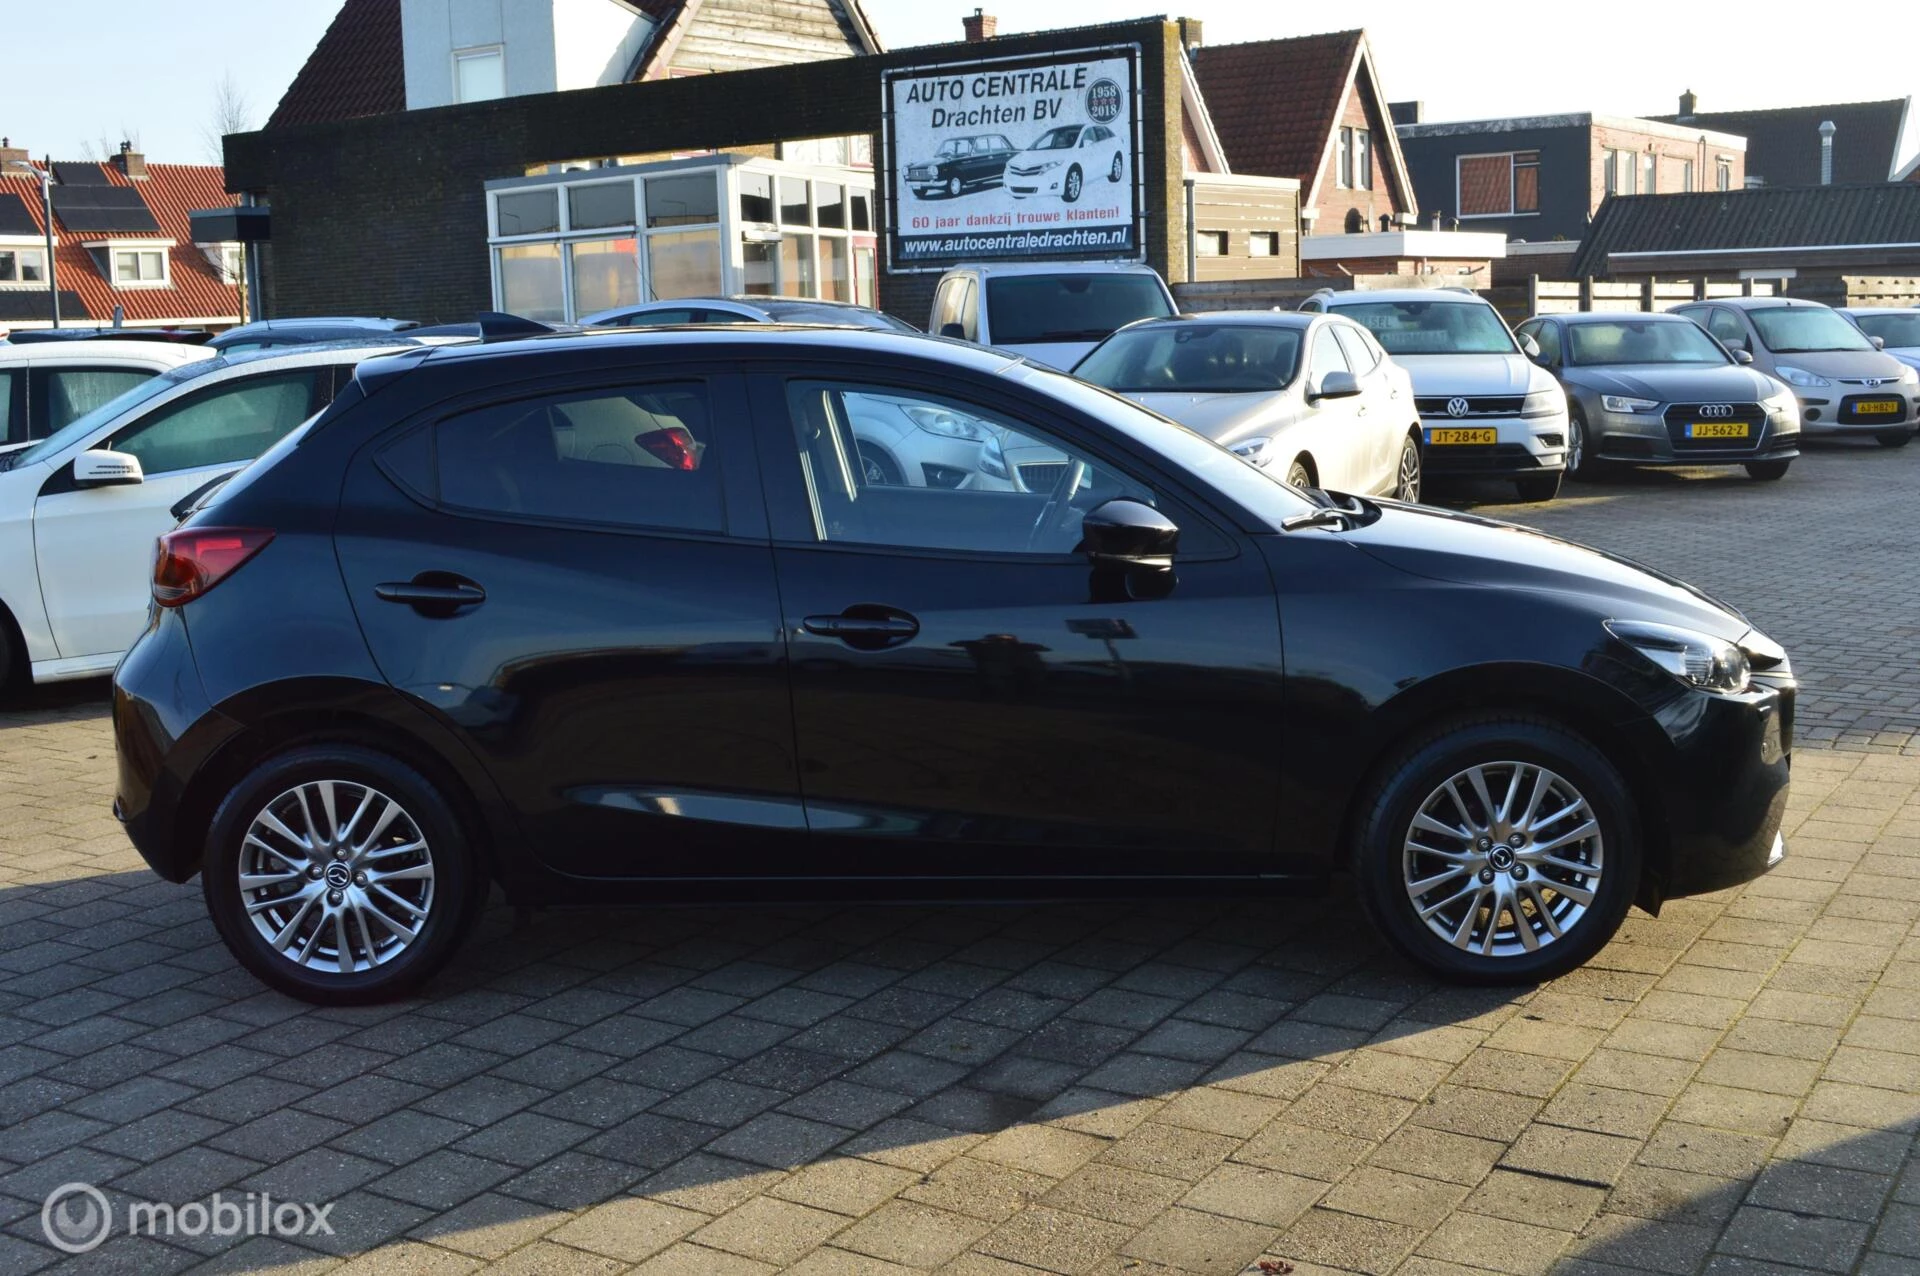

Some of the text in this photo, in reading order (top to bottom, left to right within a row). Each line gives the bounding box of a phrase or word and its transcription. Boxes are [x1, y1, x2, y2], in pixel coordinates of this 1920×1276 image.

[906, 67, 1087, 103] AUTO CENTRALE
[1092, 85, 1117, 98] 1958
[932, 98, 1063, 128] Drachten BV
[1092, 104, 1117, 117] 2018
[912, 206, 1120, 229] 60 jaar dankzij trouwe klanten!
[904, 227, 1127, 253] www.autocentraledrachten.nl
[1435, 430, 1492, 442] JT-284-G
[1696, 425, 1744, 436] JJ-562-Z
